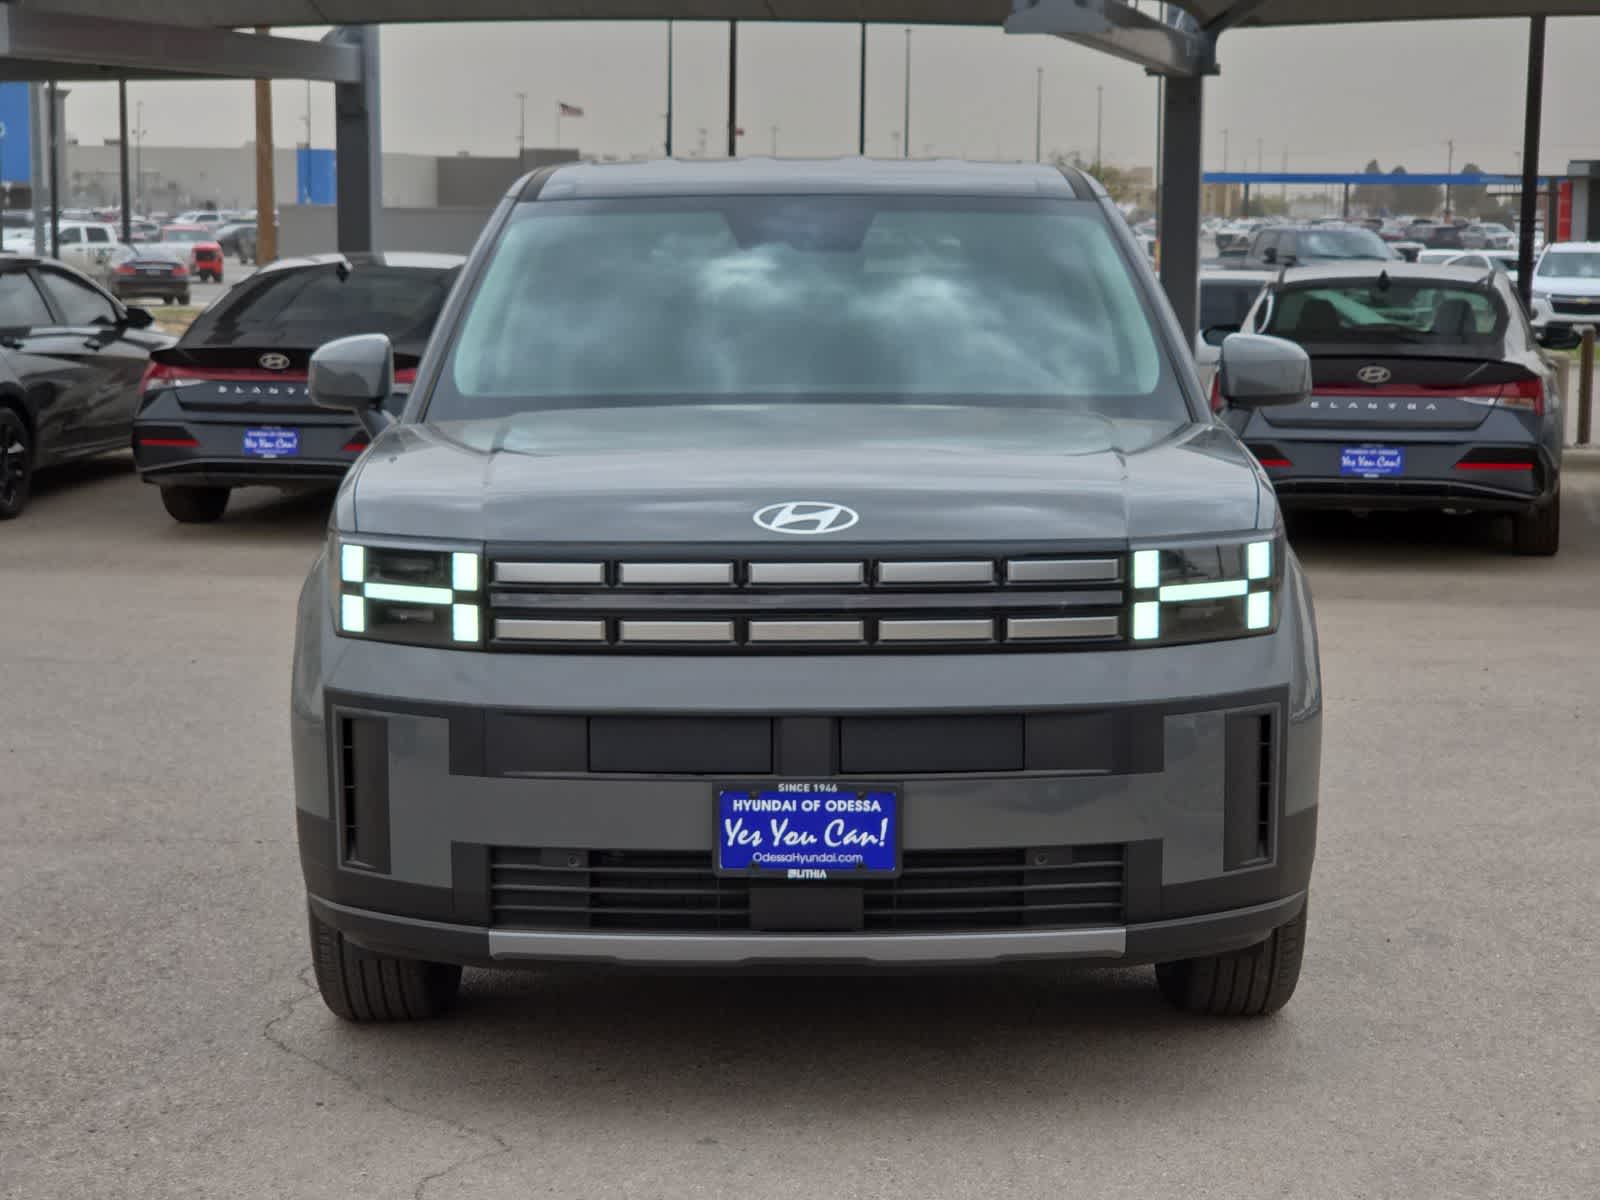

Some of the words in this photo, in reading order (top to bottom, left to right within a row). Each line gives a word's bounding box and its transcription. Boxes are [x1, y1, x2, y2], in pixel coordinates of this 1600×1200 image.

[217, 385, 310, 395] ELANT
[778, 783, 810, 793] SINCE
[813, 783, 838, 793] 1946
[733, 800, 796, 812] HYUNDAI
[801, 800, 821, 812] OF
[825, 800, 882, 812] ODESSA
[724, 817, 763, 847] Yes
[770, 817, 818, 847] You
[824, 817, 889, 847] Can!
[752, 852, 864, 863] OdessaHyundai.com
